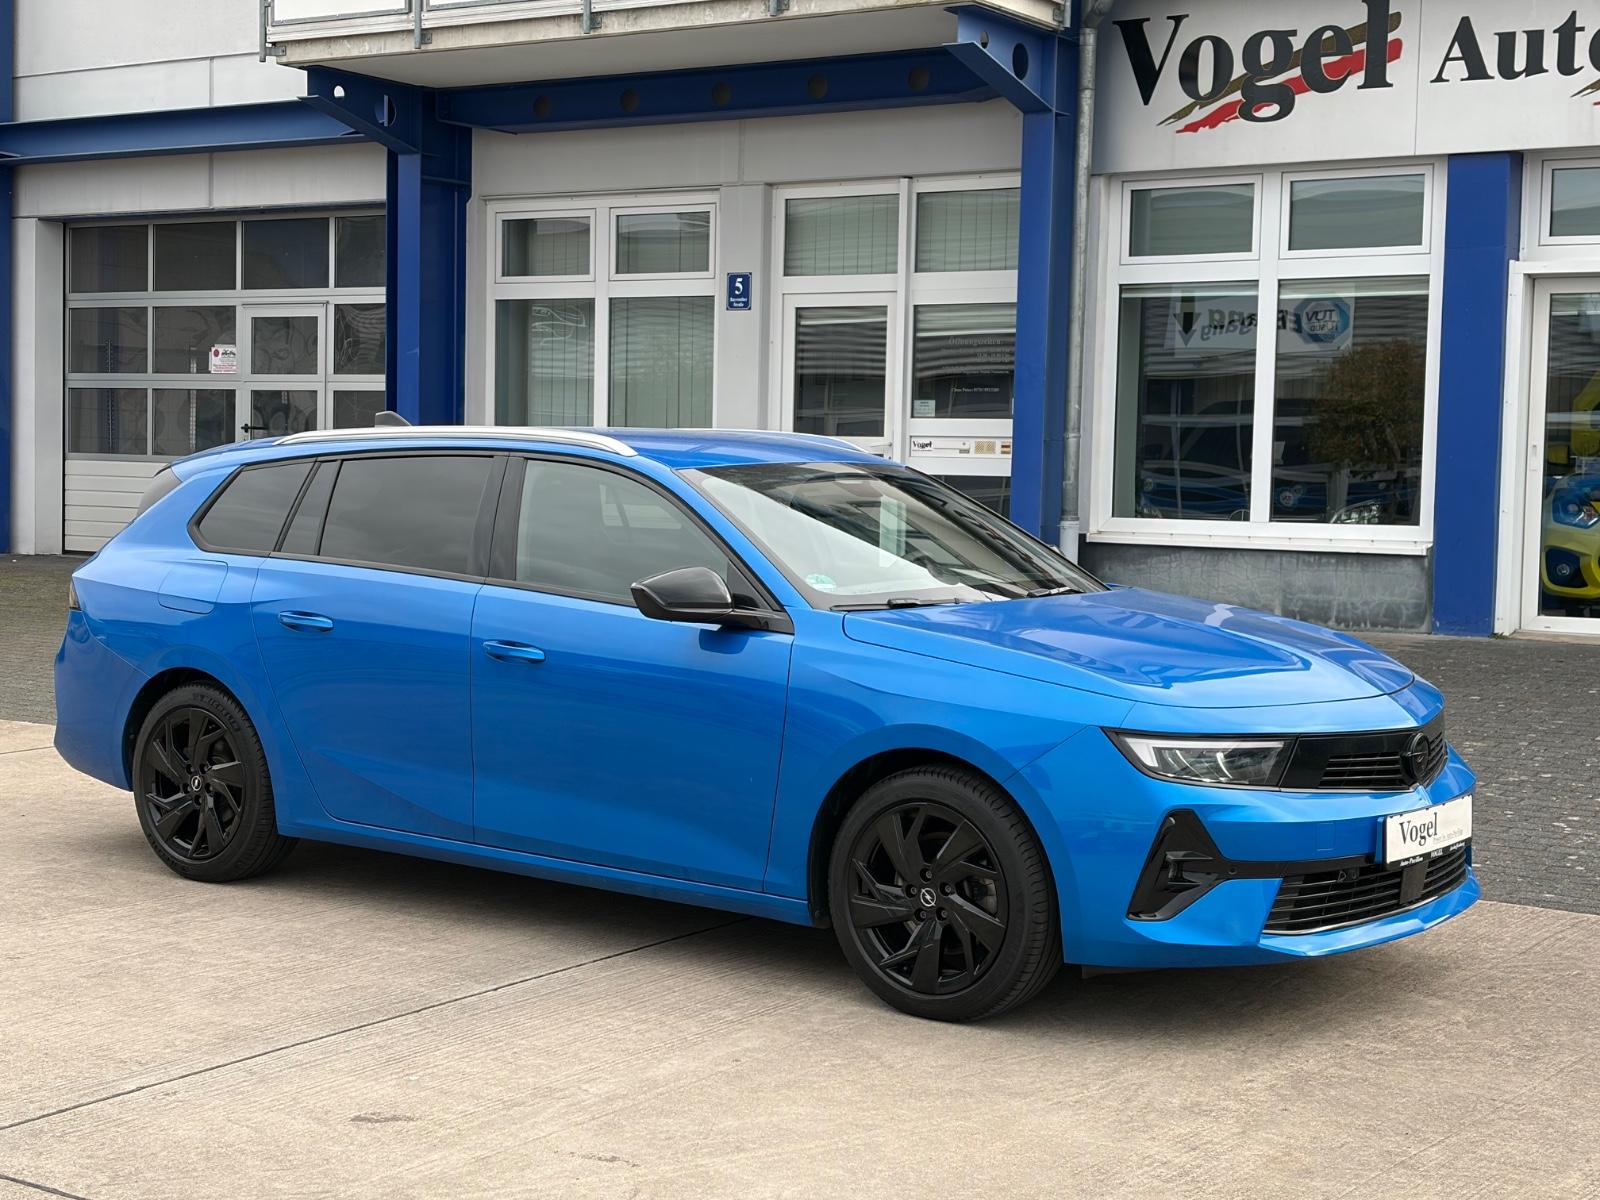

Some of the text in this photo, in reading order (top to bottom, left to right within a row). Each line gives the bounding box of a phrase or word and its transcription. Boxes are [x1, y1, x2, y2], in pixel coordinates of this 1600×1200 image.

[1112, 0, 1600, 122] Vogel Aut
[734, 278, 743, 295] 5
[912, 440, 932, 449] Vogel
[1399, 812, 1438, 846] Vogel
